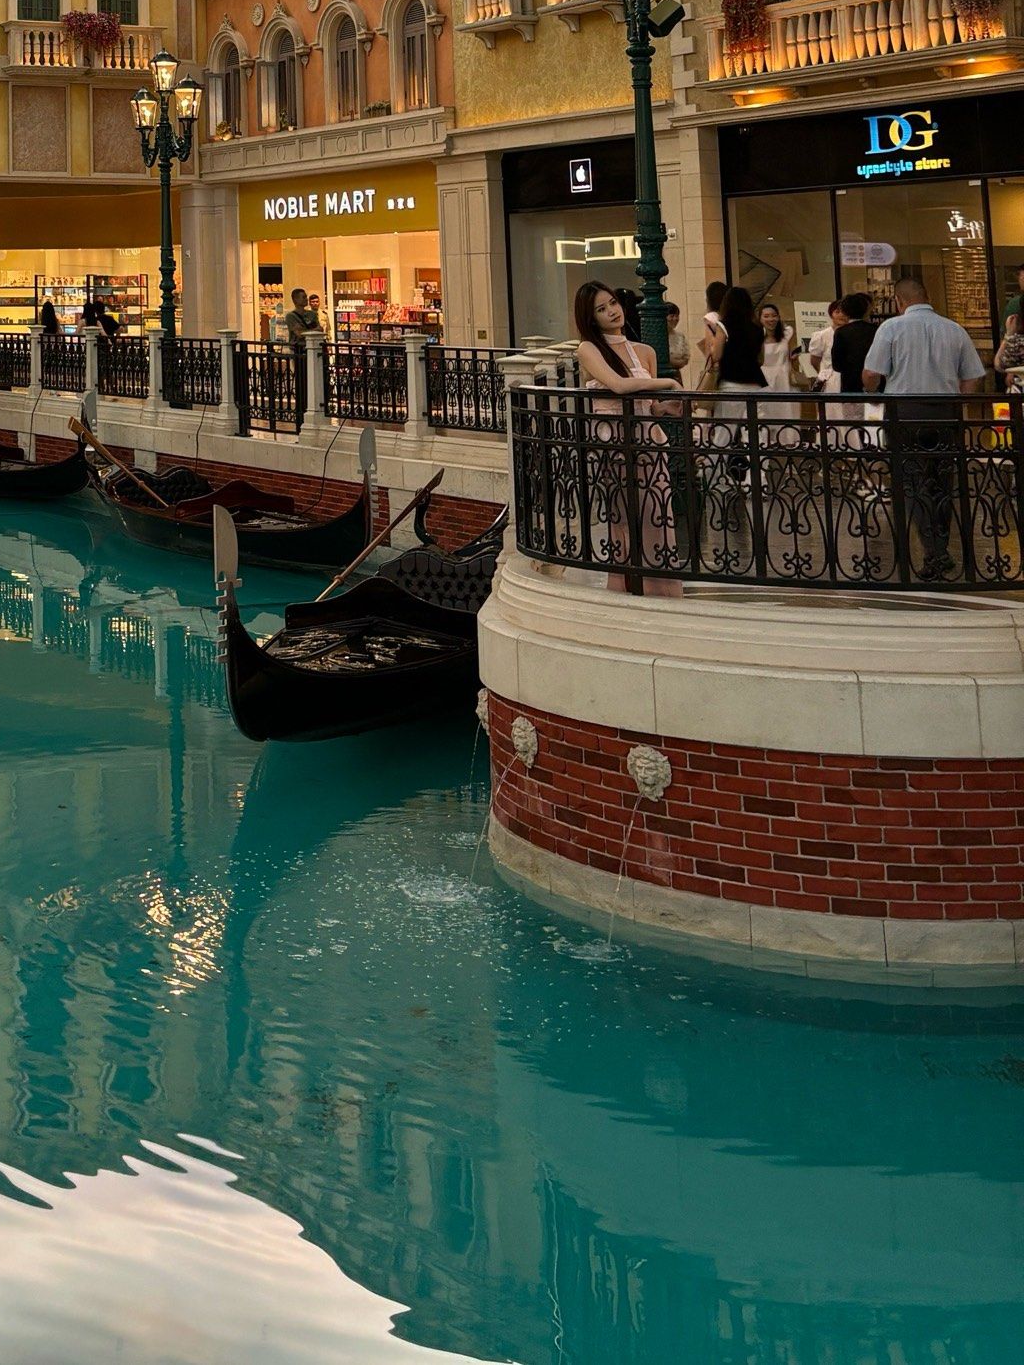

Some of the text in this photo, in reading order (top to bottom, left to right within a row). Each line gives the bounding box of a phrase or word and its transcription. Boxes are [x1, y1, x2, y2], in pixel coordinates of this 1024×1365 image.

[915, 157, 951, 171] store
[264, 194, 319, 220] NOBLE
[325, 189, 376, 215] MART
